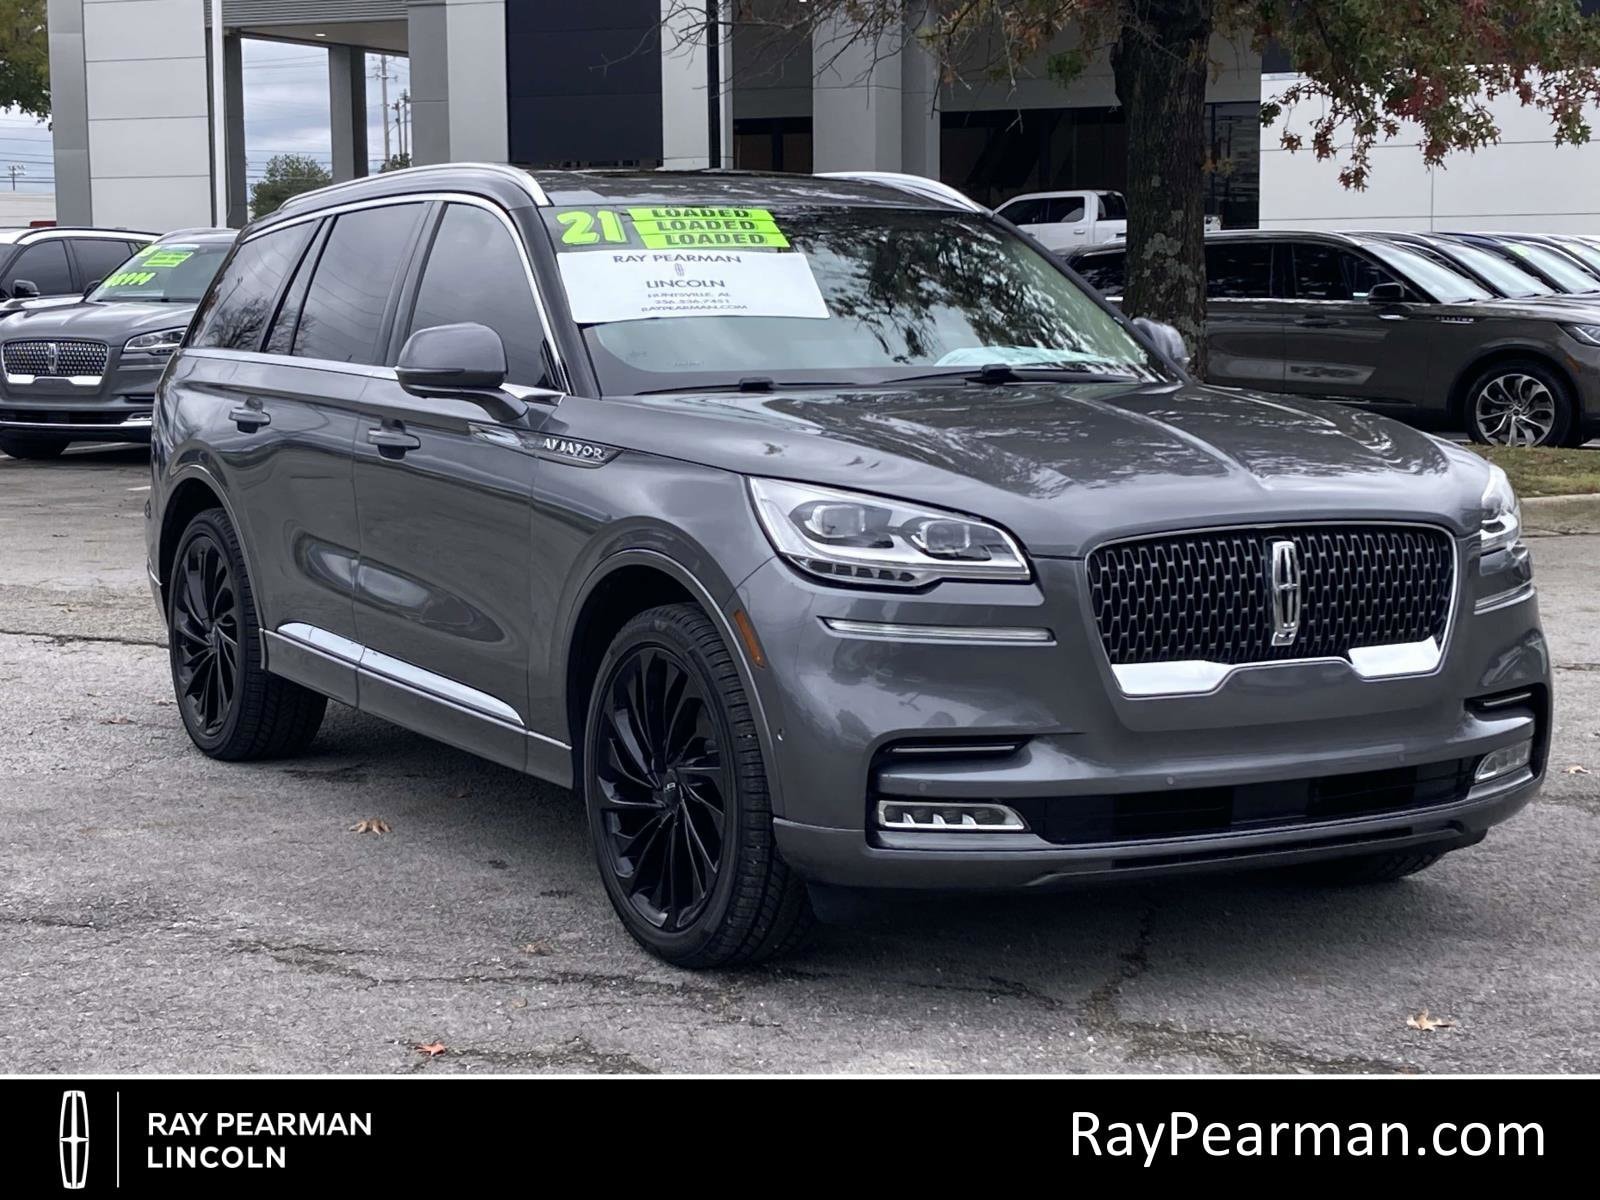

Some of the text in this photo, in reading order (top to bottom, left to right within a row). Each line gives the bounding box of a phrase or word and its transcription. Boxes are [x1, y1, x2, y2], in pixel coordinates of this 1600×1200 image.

[652, 208, 752, 218] LOADED
[556, 211, 628, 245] 21
[658, 220, 757, 231] LOADED
[665, 233, 766, 245] LOADED
[613, 254, 742, 264] RAY PEARMAN
[646, 279, 726, 289] LINCOLN
[543, 438, 604, 459] AVIATOR
